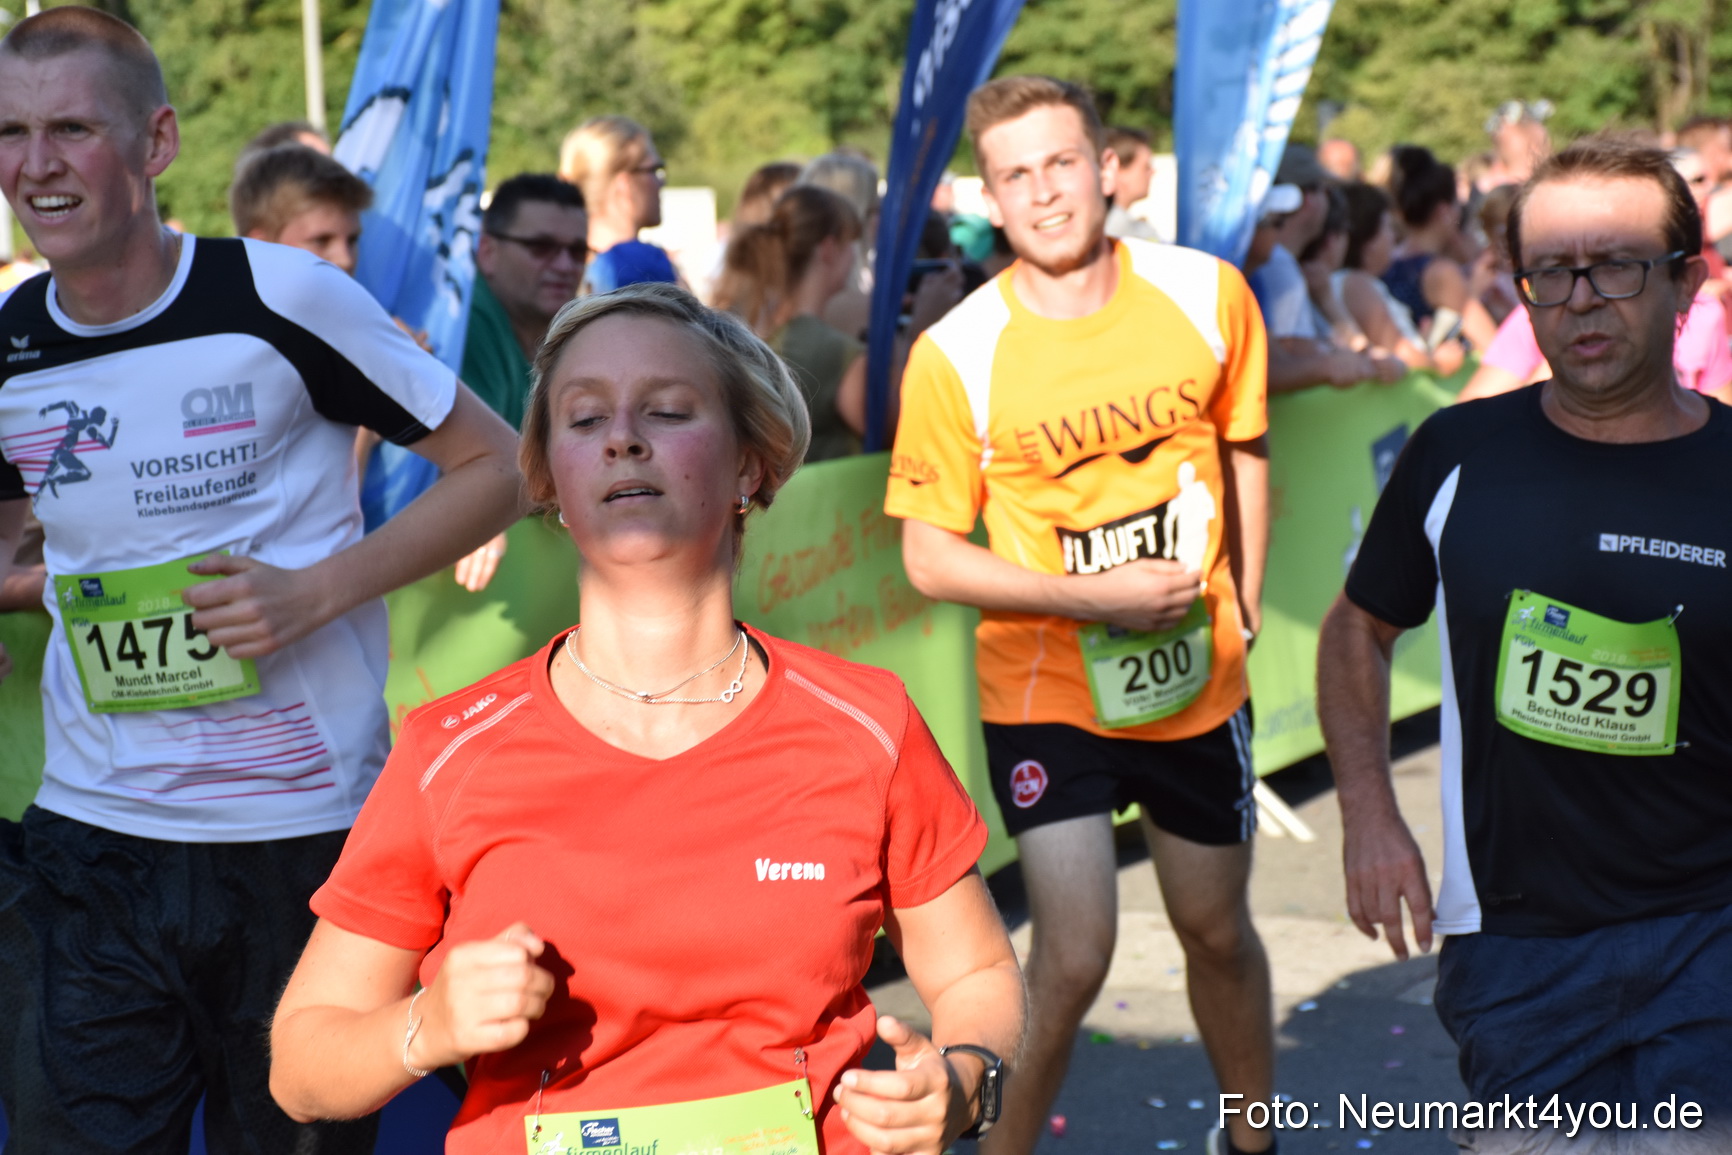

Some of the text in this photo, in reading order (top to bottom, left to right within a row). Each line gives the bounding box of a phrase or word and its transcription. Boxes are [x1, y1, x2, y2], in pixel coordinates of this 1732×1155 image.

[6, 349, 42, 363] erima
[180, 382, 255, 422] OM
[1039, 378, 1202, 457] WINGS
[130, 442, 258, 480] VORSICHT!
[1013, 427, 1043, 465] BIT
[133, 471, 257, 505] Freilaufende
[136, 488, 258, 519] Klebebandspezialisten
[1619, 534, 1727, 569] PFLEIDERER
[86, 612, 220, 672] 1475
[1530, 617, 1589, 646] firmenlauf
[1118, 639, 1193, 694] 200
[1591, 649, 1629, 665] 2018
[114, 667, 203, 688] Mundt Marcel
[183, 680, 214, 693] GmbH
[1521, 648, 1657, 719] 1529
[462, 692, 498, 721] JAKO
[1527, 700, 1591, 727] Bechtold
[1594, 717, 1637, 733] Klaus
[1554, 722, 1619, 742] Deutschland
[1620, 732, 1652, 743] GmbH
[755, 858, 825, 882] Verena
